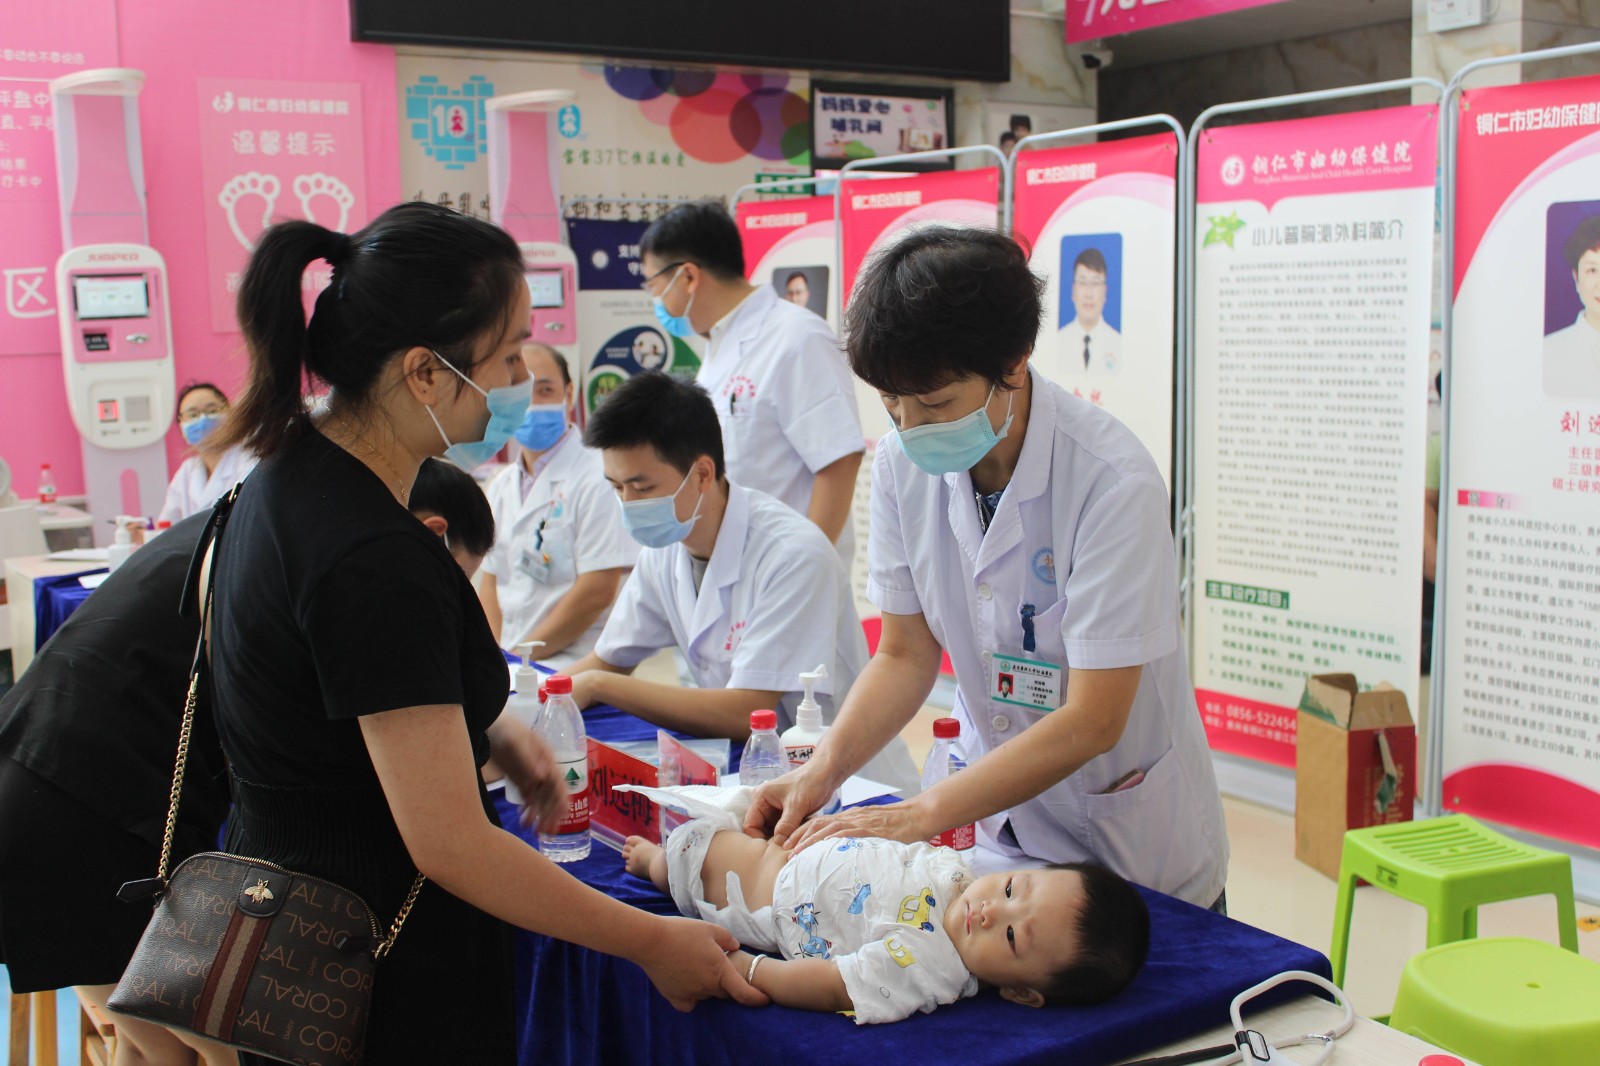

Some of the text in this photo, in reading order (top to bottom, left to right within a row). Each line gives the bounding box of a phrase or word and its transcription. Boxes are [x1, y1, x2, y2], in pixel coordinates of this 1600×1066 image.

[1476, 101, 1600, 136] 铜仁市妇幼保健
[231, 129, 336, 157] 温馨提示
[1251, 140, 1412, 175] 铜仁市妇幼保健院
[3, 266, 56, 319] 区
[259, 975, 347, 1019] CORAL
